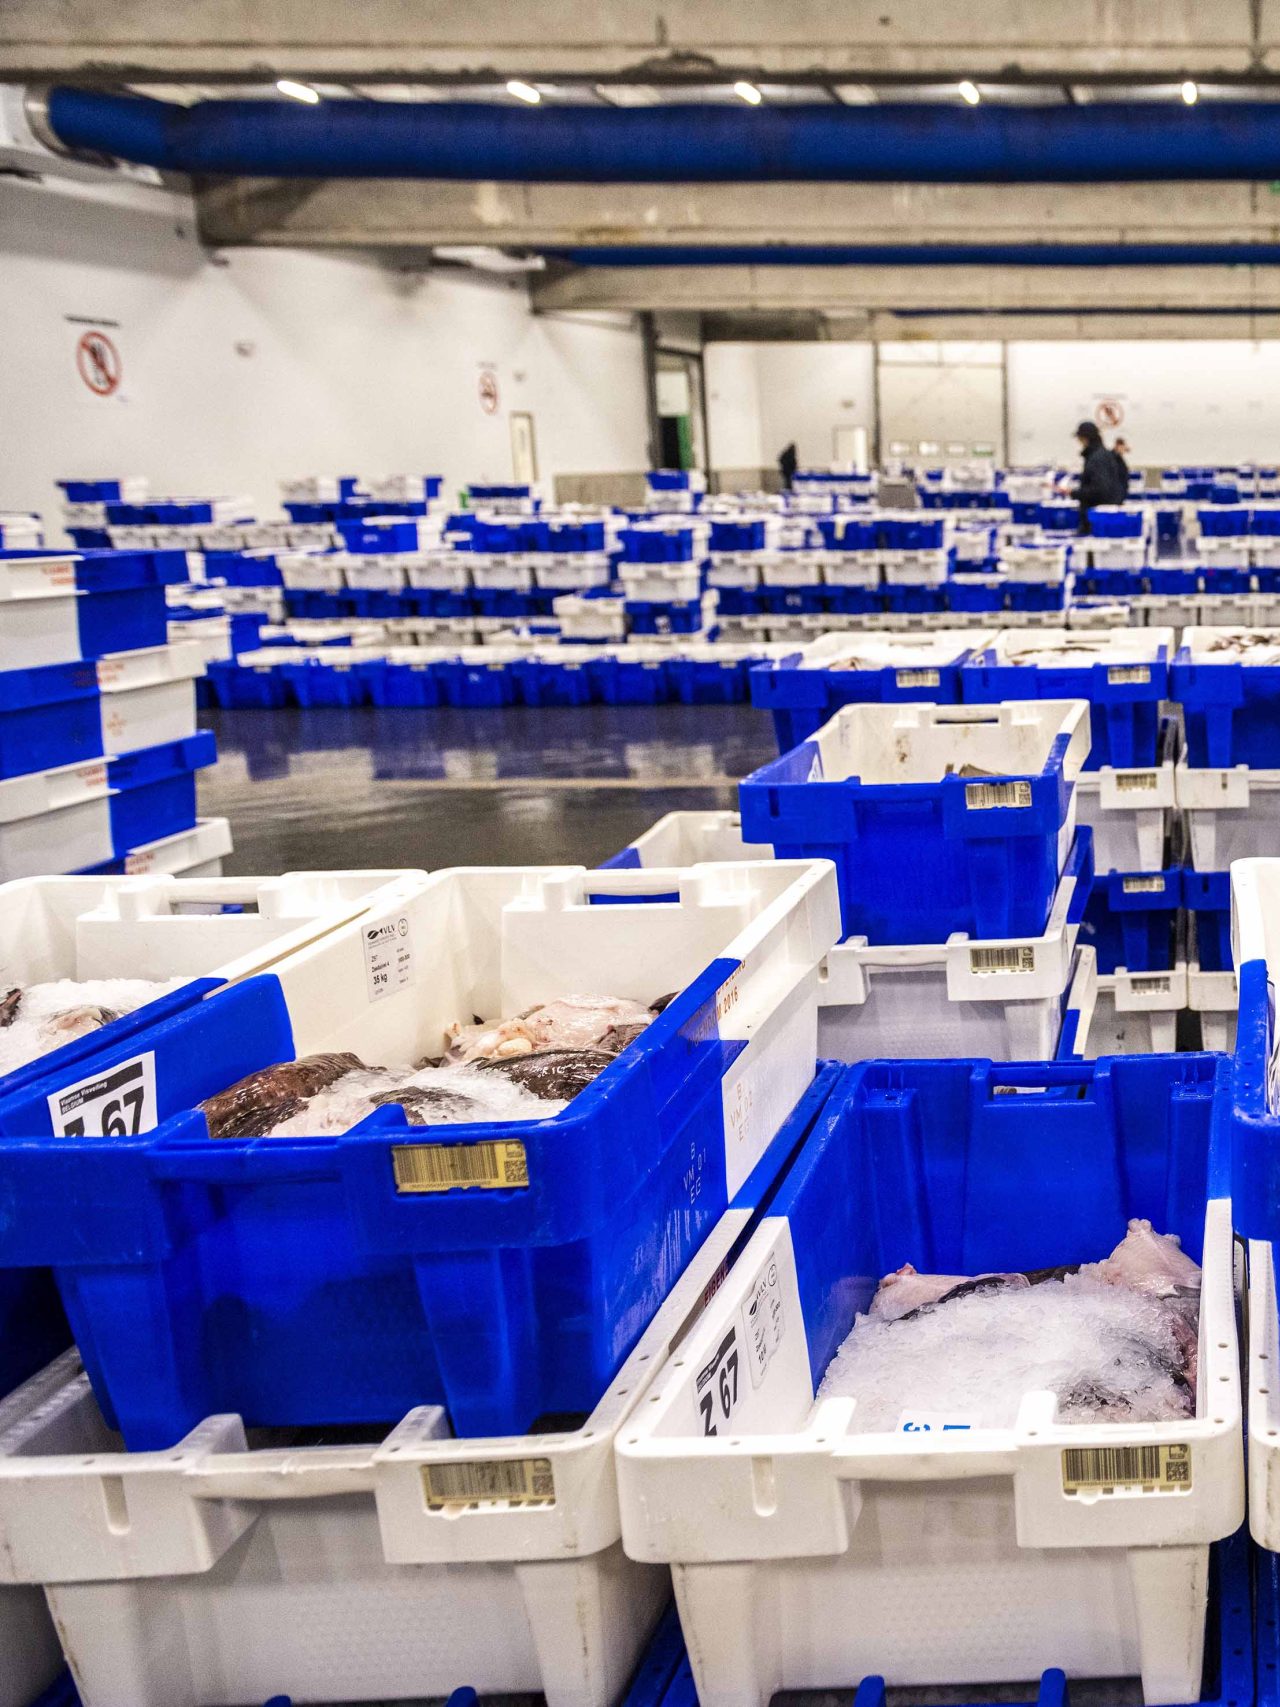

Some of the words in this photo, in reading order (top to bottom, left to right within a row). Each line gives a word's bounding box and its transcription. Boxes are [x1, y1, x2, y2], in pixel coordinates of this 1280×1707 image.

[724, 986, 739, 1014] 2016
[102, 1086, 144, 1137] 67
[730, 1104, 742, 1128] VM
[683, 1165, 695, 1191] VM
[690, 1176, 701, 1205] EG
[719, 1348, 739, 1419] 67
